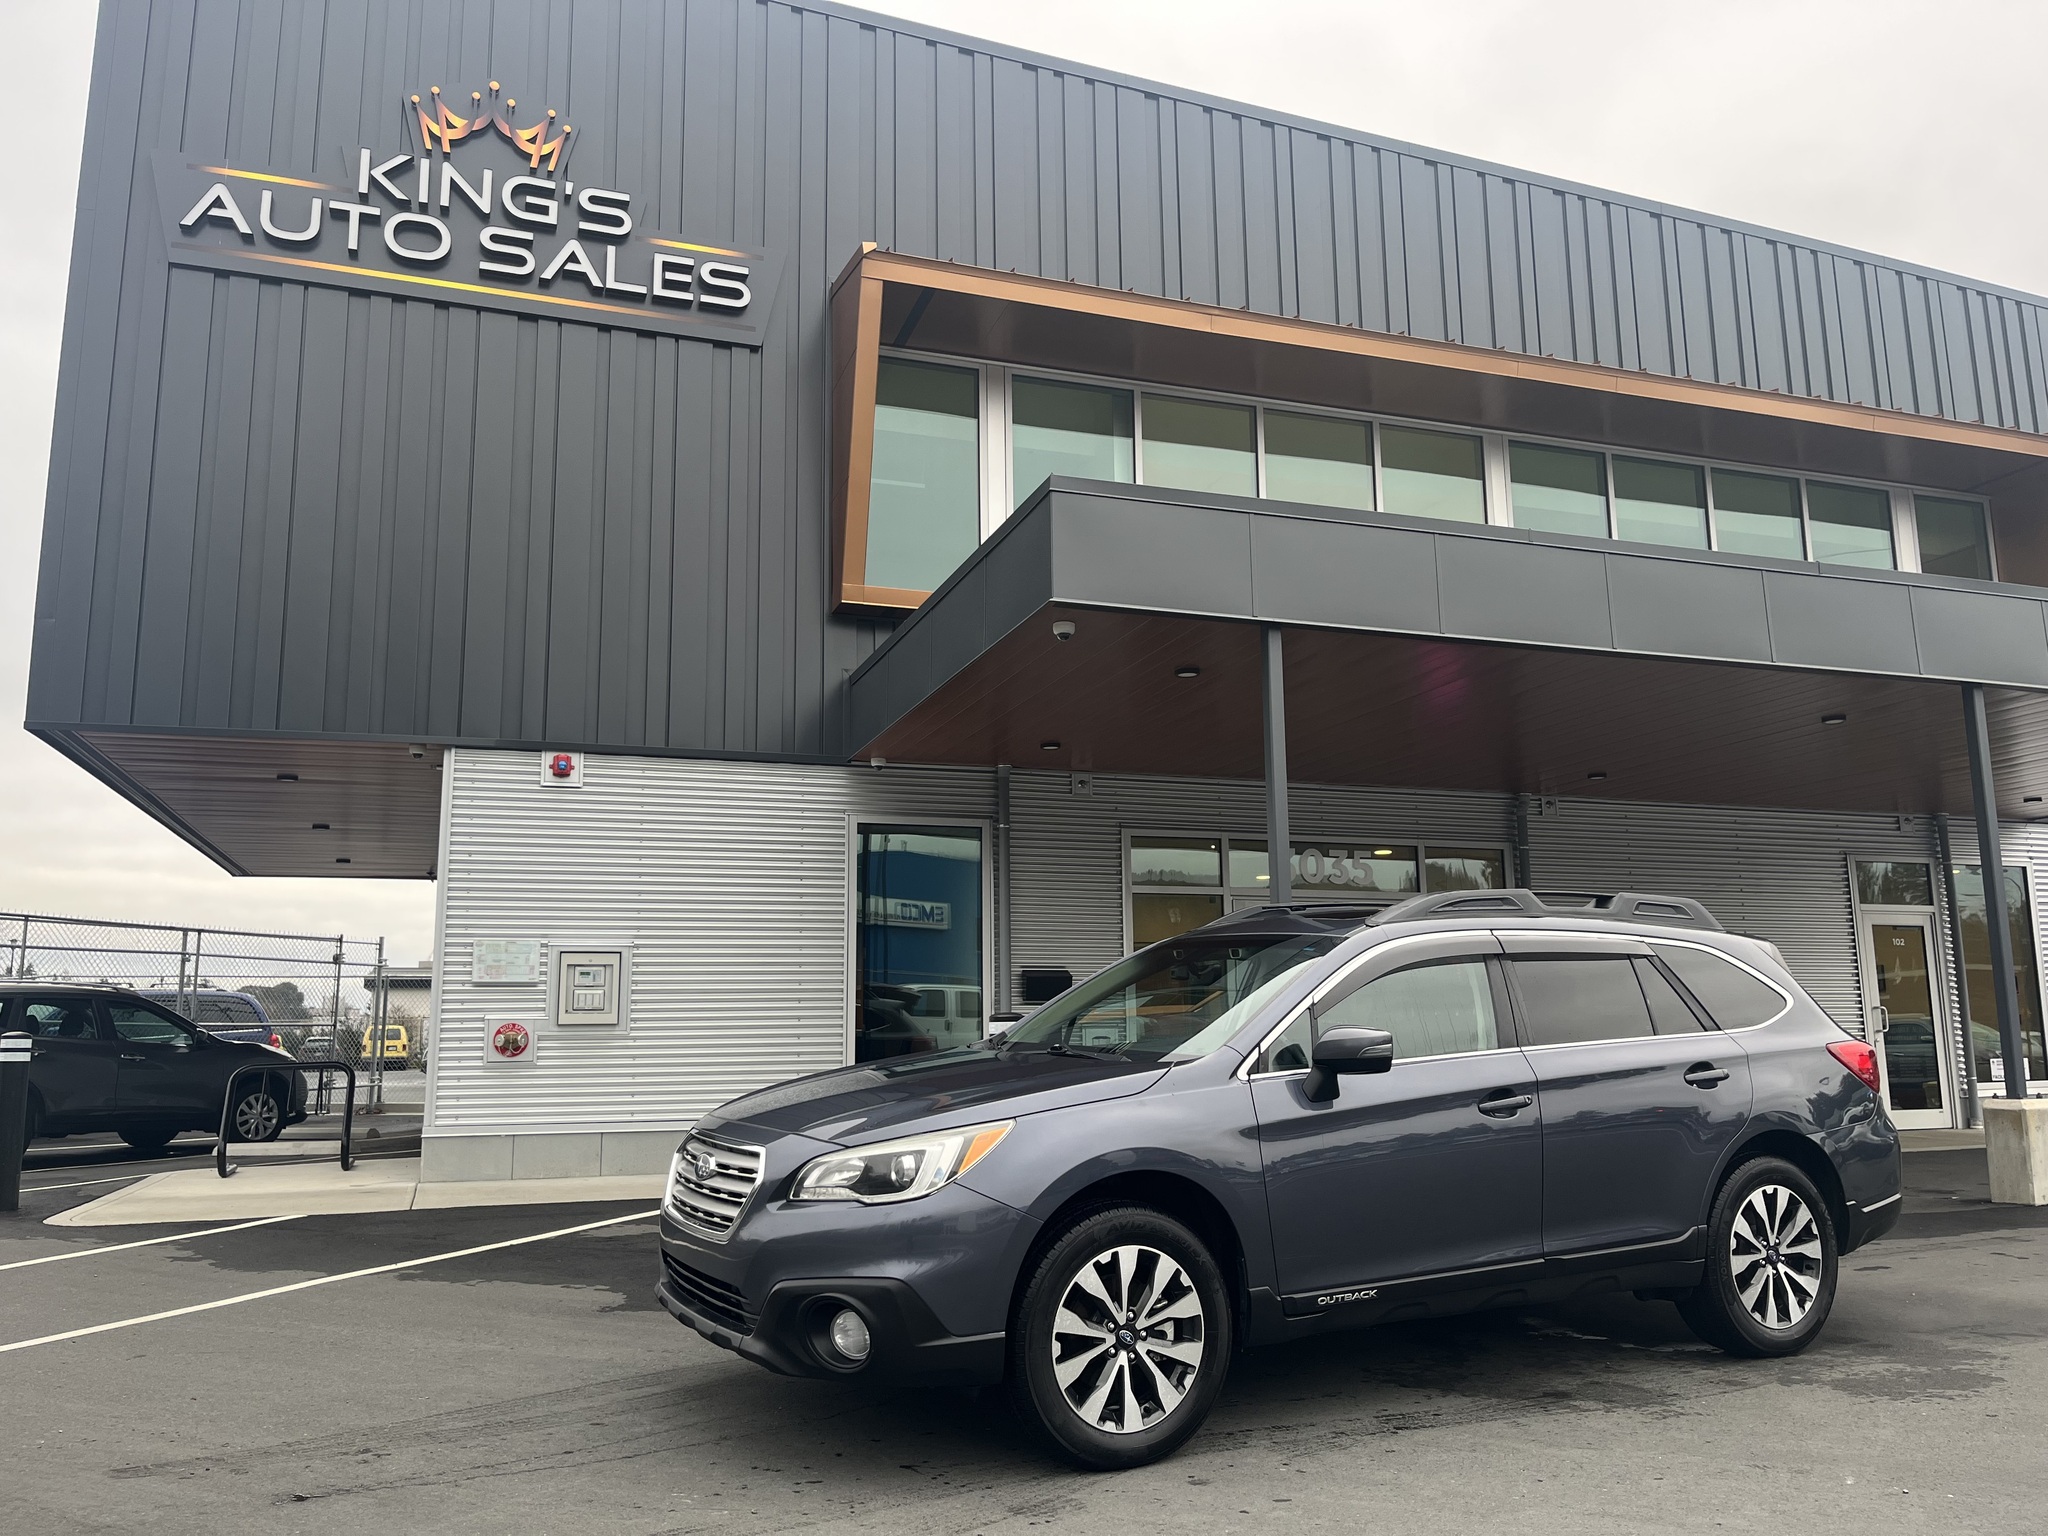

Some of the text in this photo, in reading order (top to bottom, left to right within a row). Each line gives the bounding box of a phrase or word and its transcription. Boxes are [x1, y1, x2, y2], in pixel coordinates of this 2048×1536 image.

[358, 147, 634, 238] KING'S
[179, 182, 752, 310] AUTO SALES
[1289, 847, 1374, 886] 035
[1892, 937, 1905, 946] 102
[1317, 1289, 1378, 1305] OUTBACK
